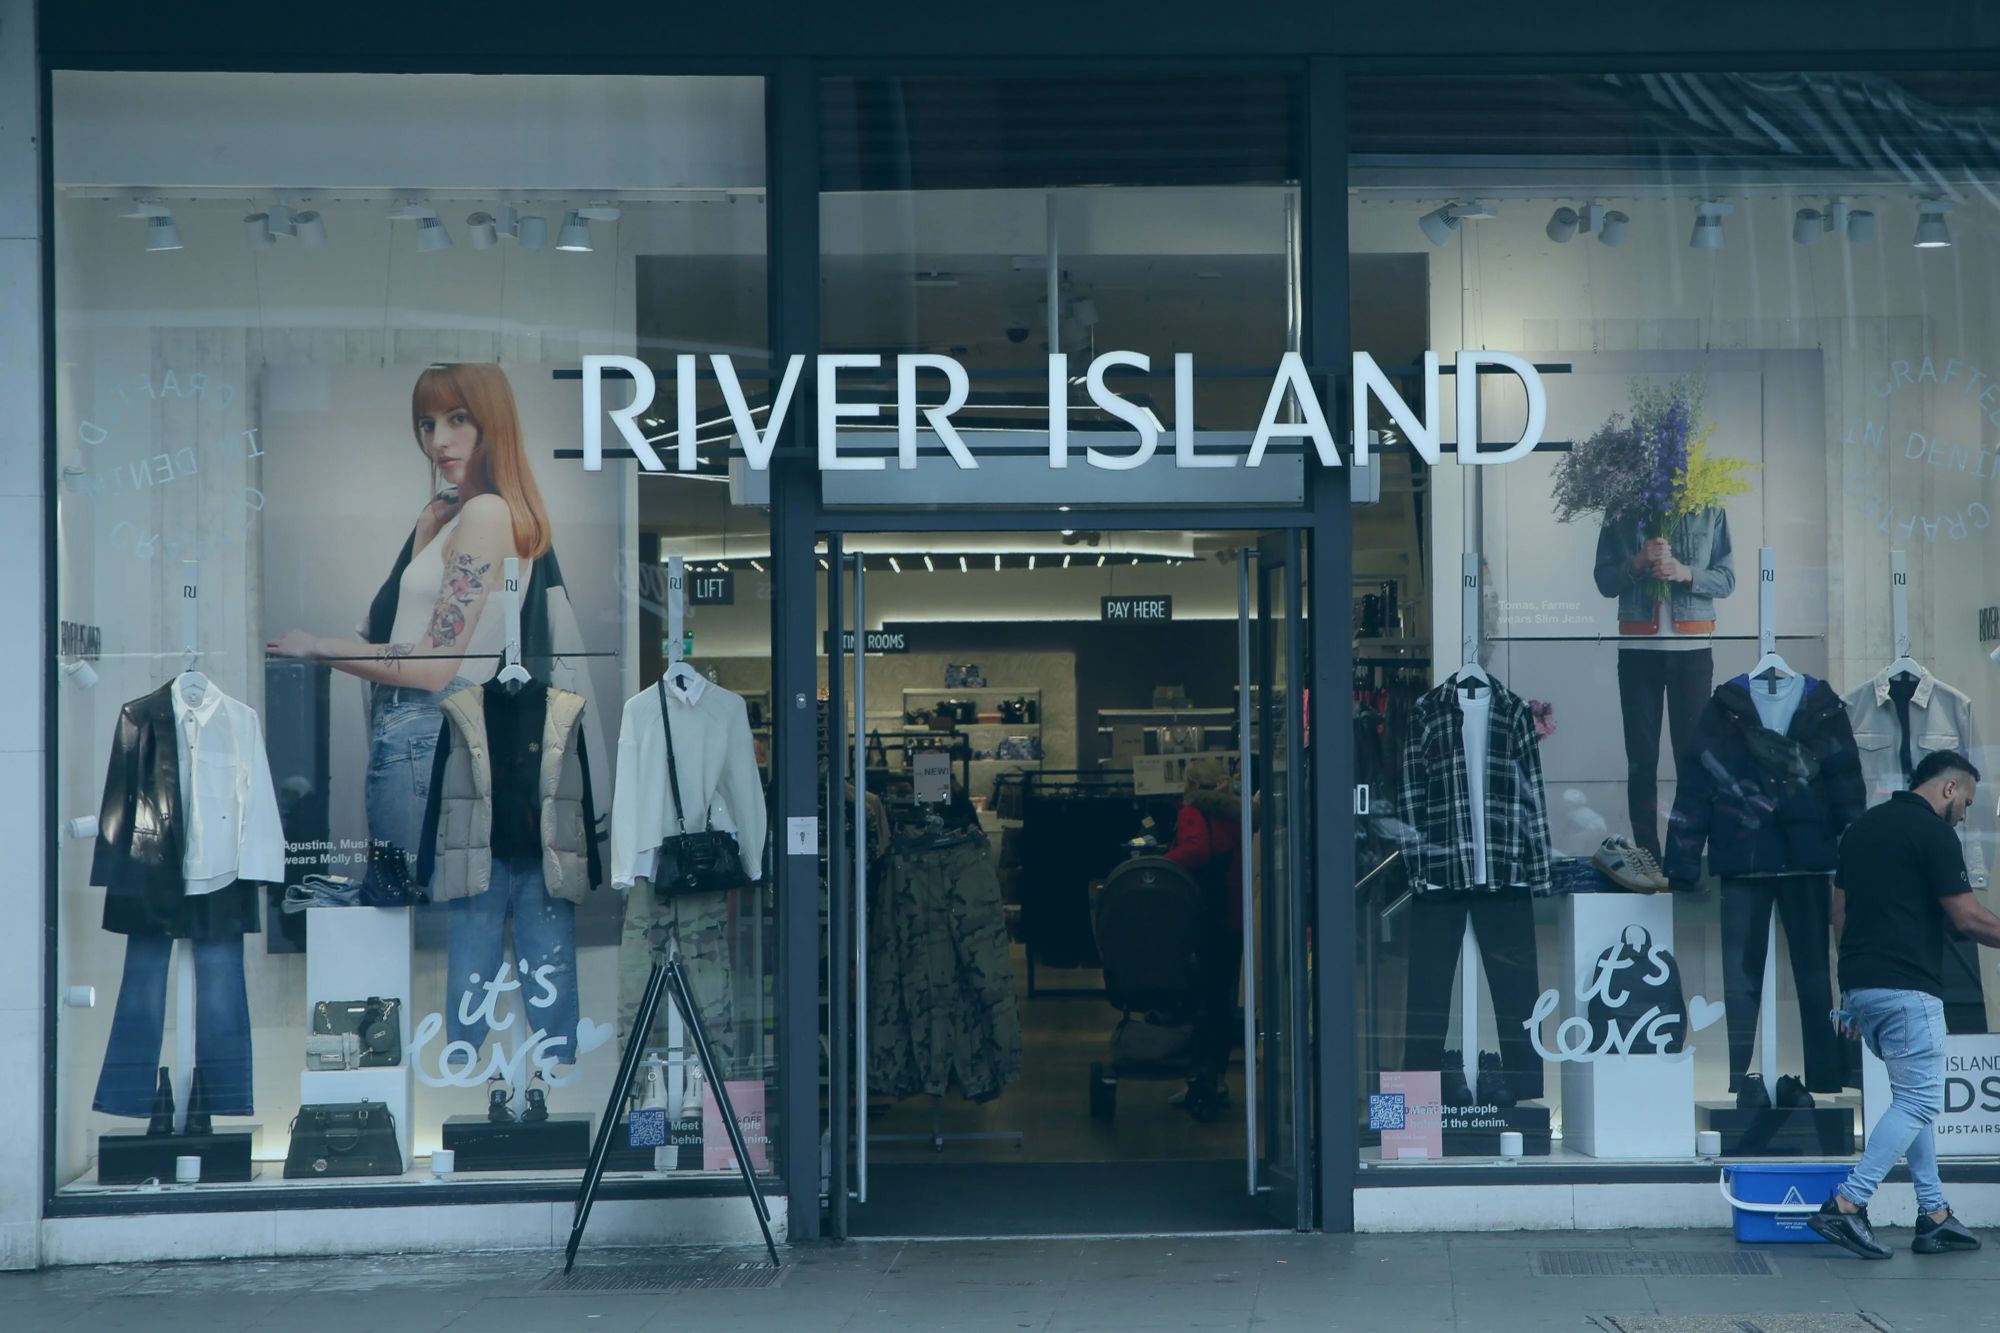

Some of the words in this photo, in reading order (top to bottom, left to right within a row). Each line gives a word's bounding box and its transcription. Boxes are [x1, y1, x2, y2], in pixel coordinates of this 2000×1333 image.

[582, 354, 979, 471] RIVER
[1049, 349, 1547, 470] ISLAND
[1844, 416, 1885, 448] IN
[697, 578, 725, 598] LIFT
[1107, 602, 1130, 618] PAY
[1133, 601, 1165, 618] HERE
[1498, 600, 1539, 611] Tomas,
[1541, 600, 1582, 610] Farmer
[1535, 614, 1559, 624] Slim
[1562, 614, 1595, 624] Jeans
[867, 634, 904, 649] ROOMS
[284, 839, 337, 851] Agustina,
[340, 838, 391, 849] Musiia
[284, 855, 317, 865] wears
[320, 853, 351, 865] Molly
[458, 958, 558, 1031] it's
[1944, 1076, 2000, 1113] DS
[1440, 1104, 1458, 1115] the
[1461, 1104, 1498, 1116] people
[670, 1120, 699, 1131] Meet
[1451, 1118, 1468, 1128] the
[1471, 1118, 1509, 1128] denim.
[1938, 1124, 2000, 1135] UPSTAIRS
